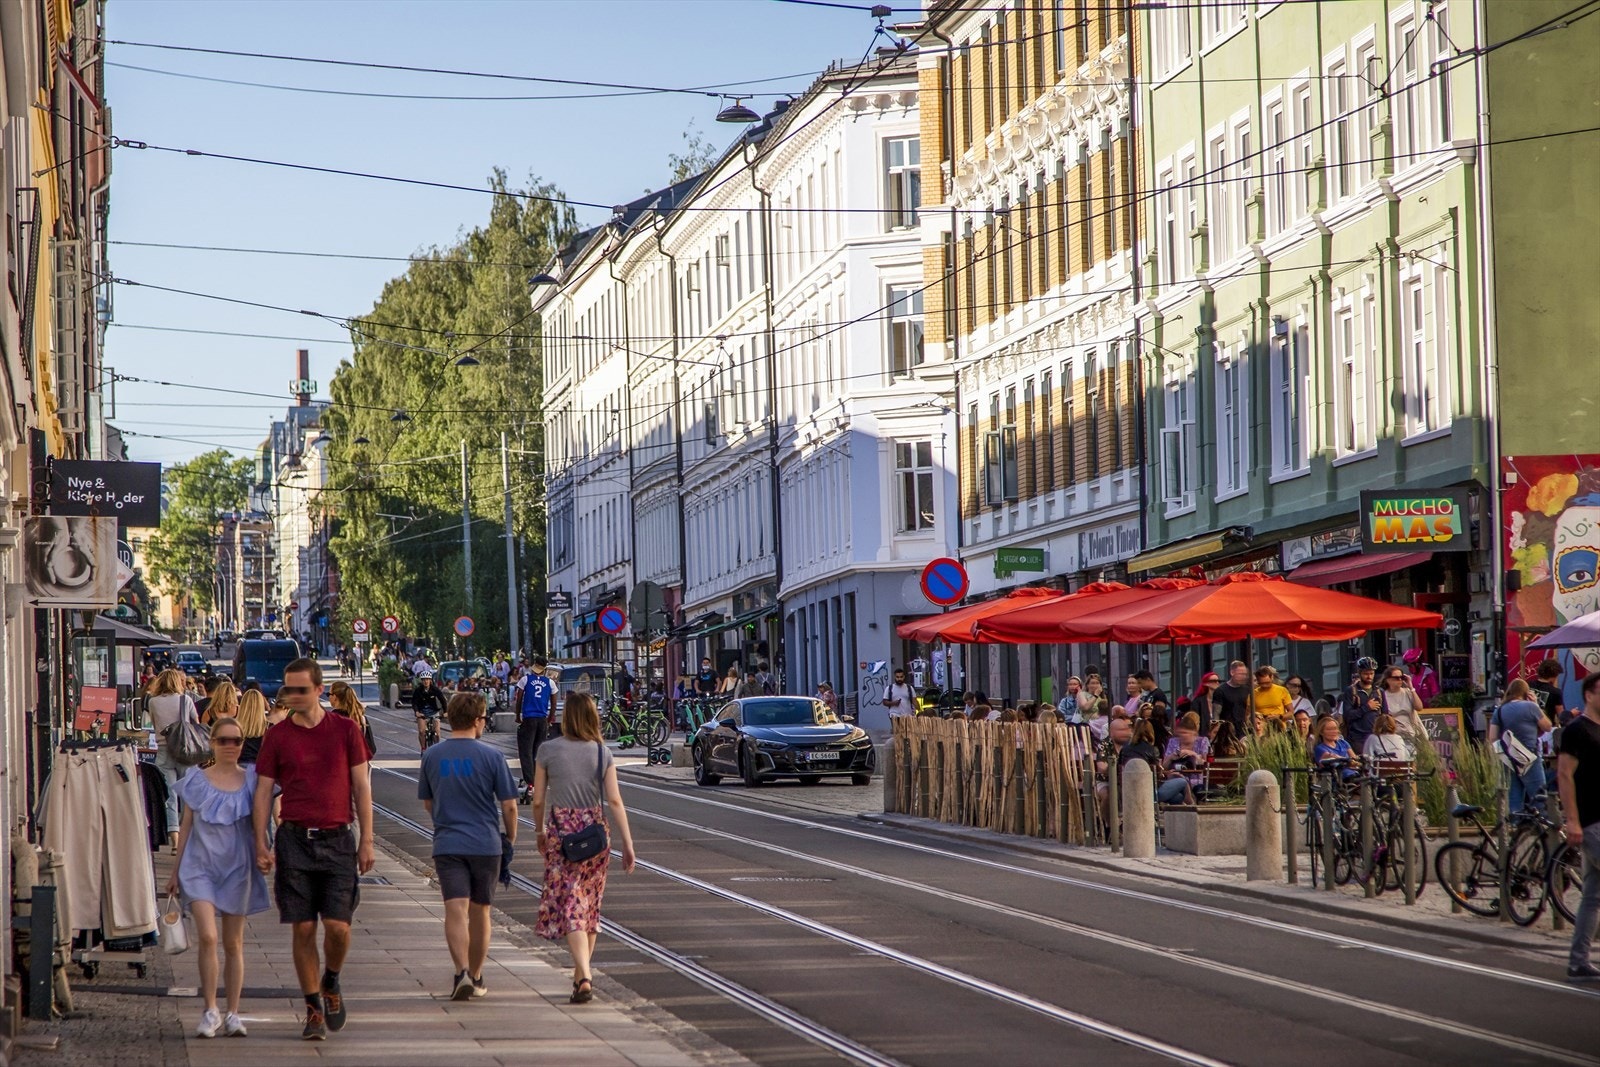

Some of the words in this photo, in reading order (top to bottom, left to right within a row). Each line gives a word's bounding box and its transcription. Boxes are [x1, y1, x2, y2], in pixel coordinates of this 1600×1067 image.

[68, 476, 93, 490] Nye
[95, 477, 105, 489] &
[1375, 499, 1452, 516] MUCHO
[1373, 517, 1453, 544] MAS
[1089, 528, 1114, 560] Velouria
[1116, 525, 1139, 554] Vintage
[534, 685, 542, 698] 2
[1421, 718, 1439, 729] Try
